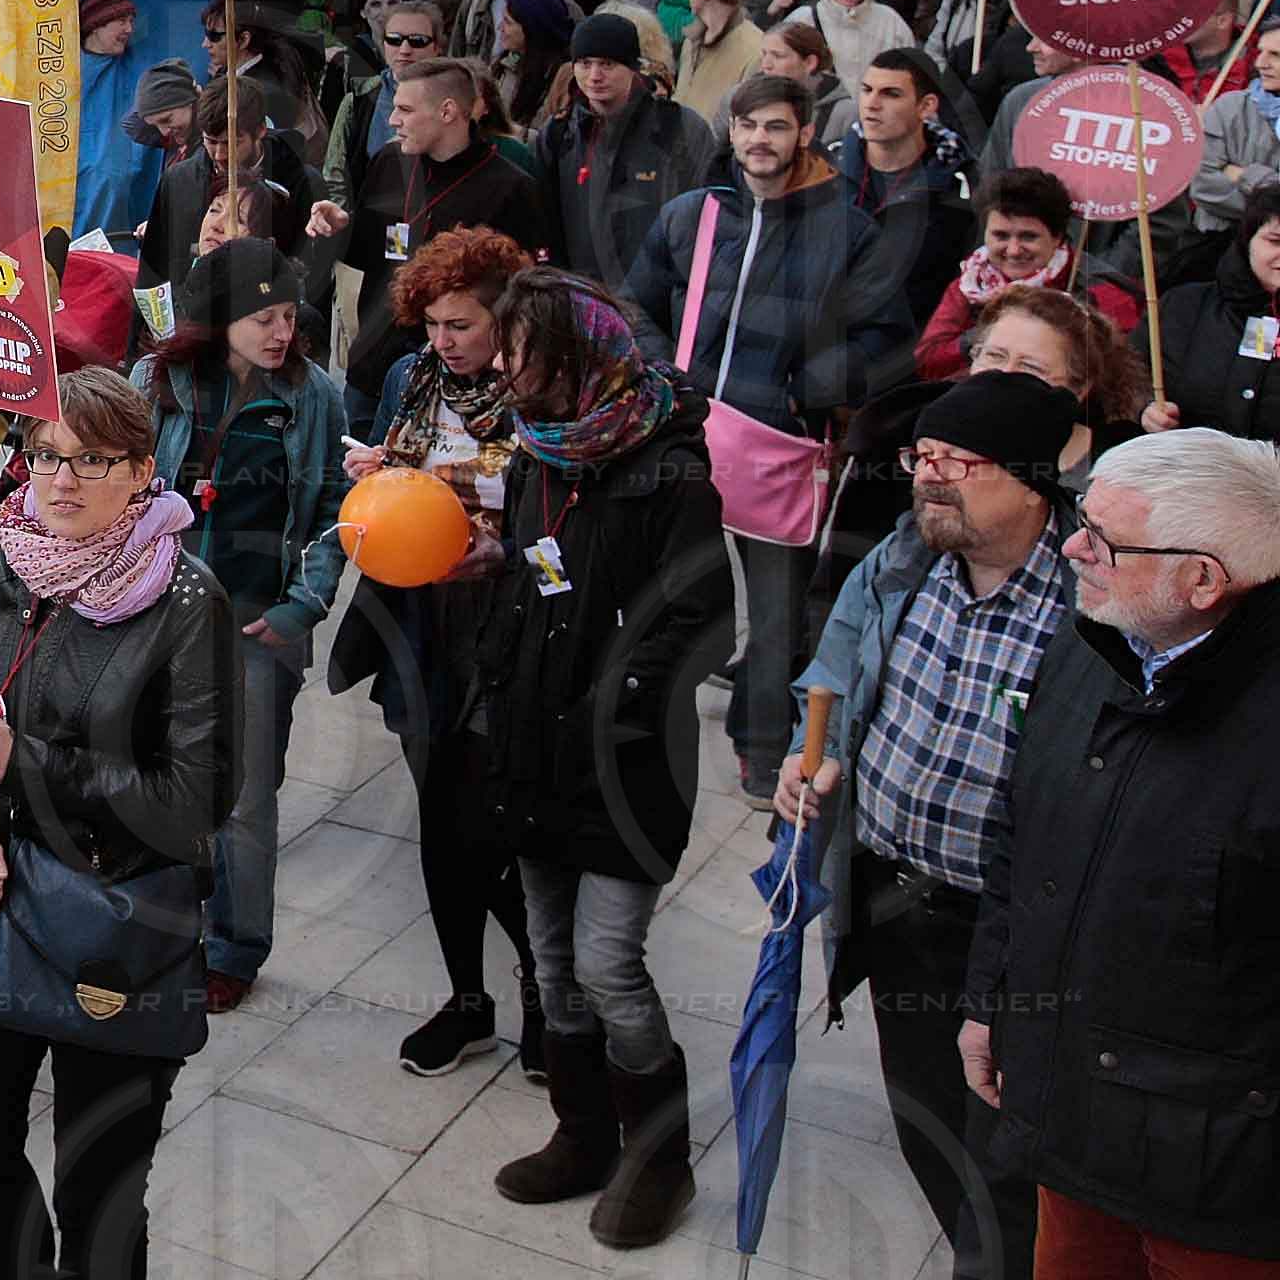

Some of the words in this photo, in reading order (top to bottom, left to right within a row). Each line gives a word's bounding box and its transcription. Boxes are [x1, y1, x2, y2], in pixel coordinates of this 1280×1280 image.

[34, 18, 65, 76] EZB
[1050, 29, 1095, 56] sieht
[1099, 38, 1163, 58] anders
[1166, 16, 1194, 41] aus
[38, 79, 72, 155] 2002
[1027, 71, 1132, 119] Transatlantisch
[1058, 107, 1173, 154] TTIP
[1049, 142, 1159, 176] STOPPEN
[6, 310, 44, 356] Partnerschaft
